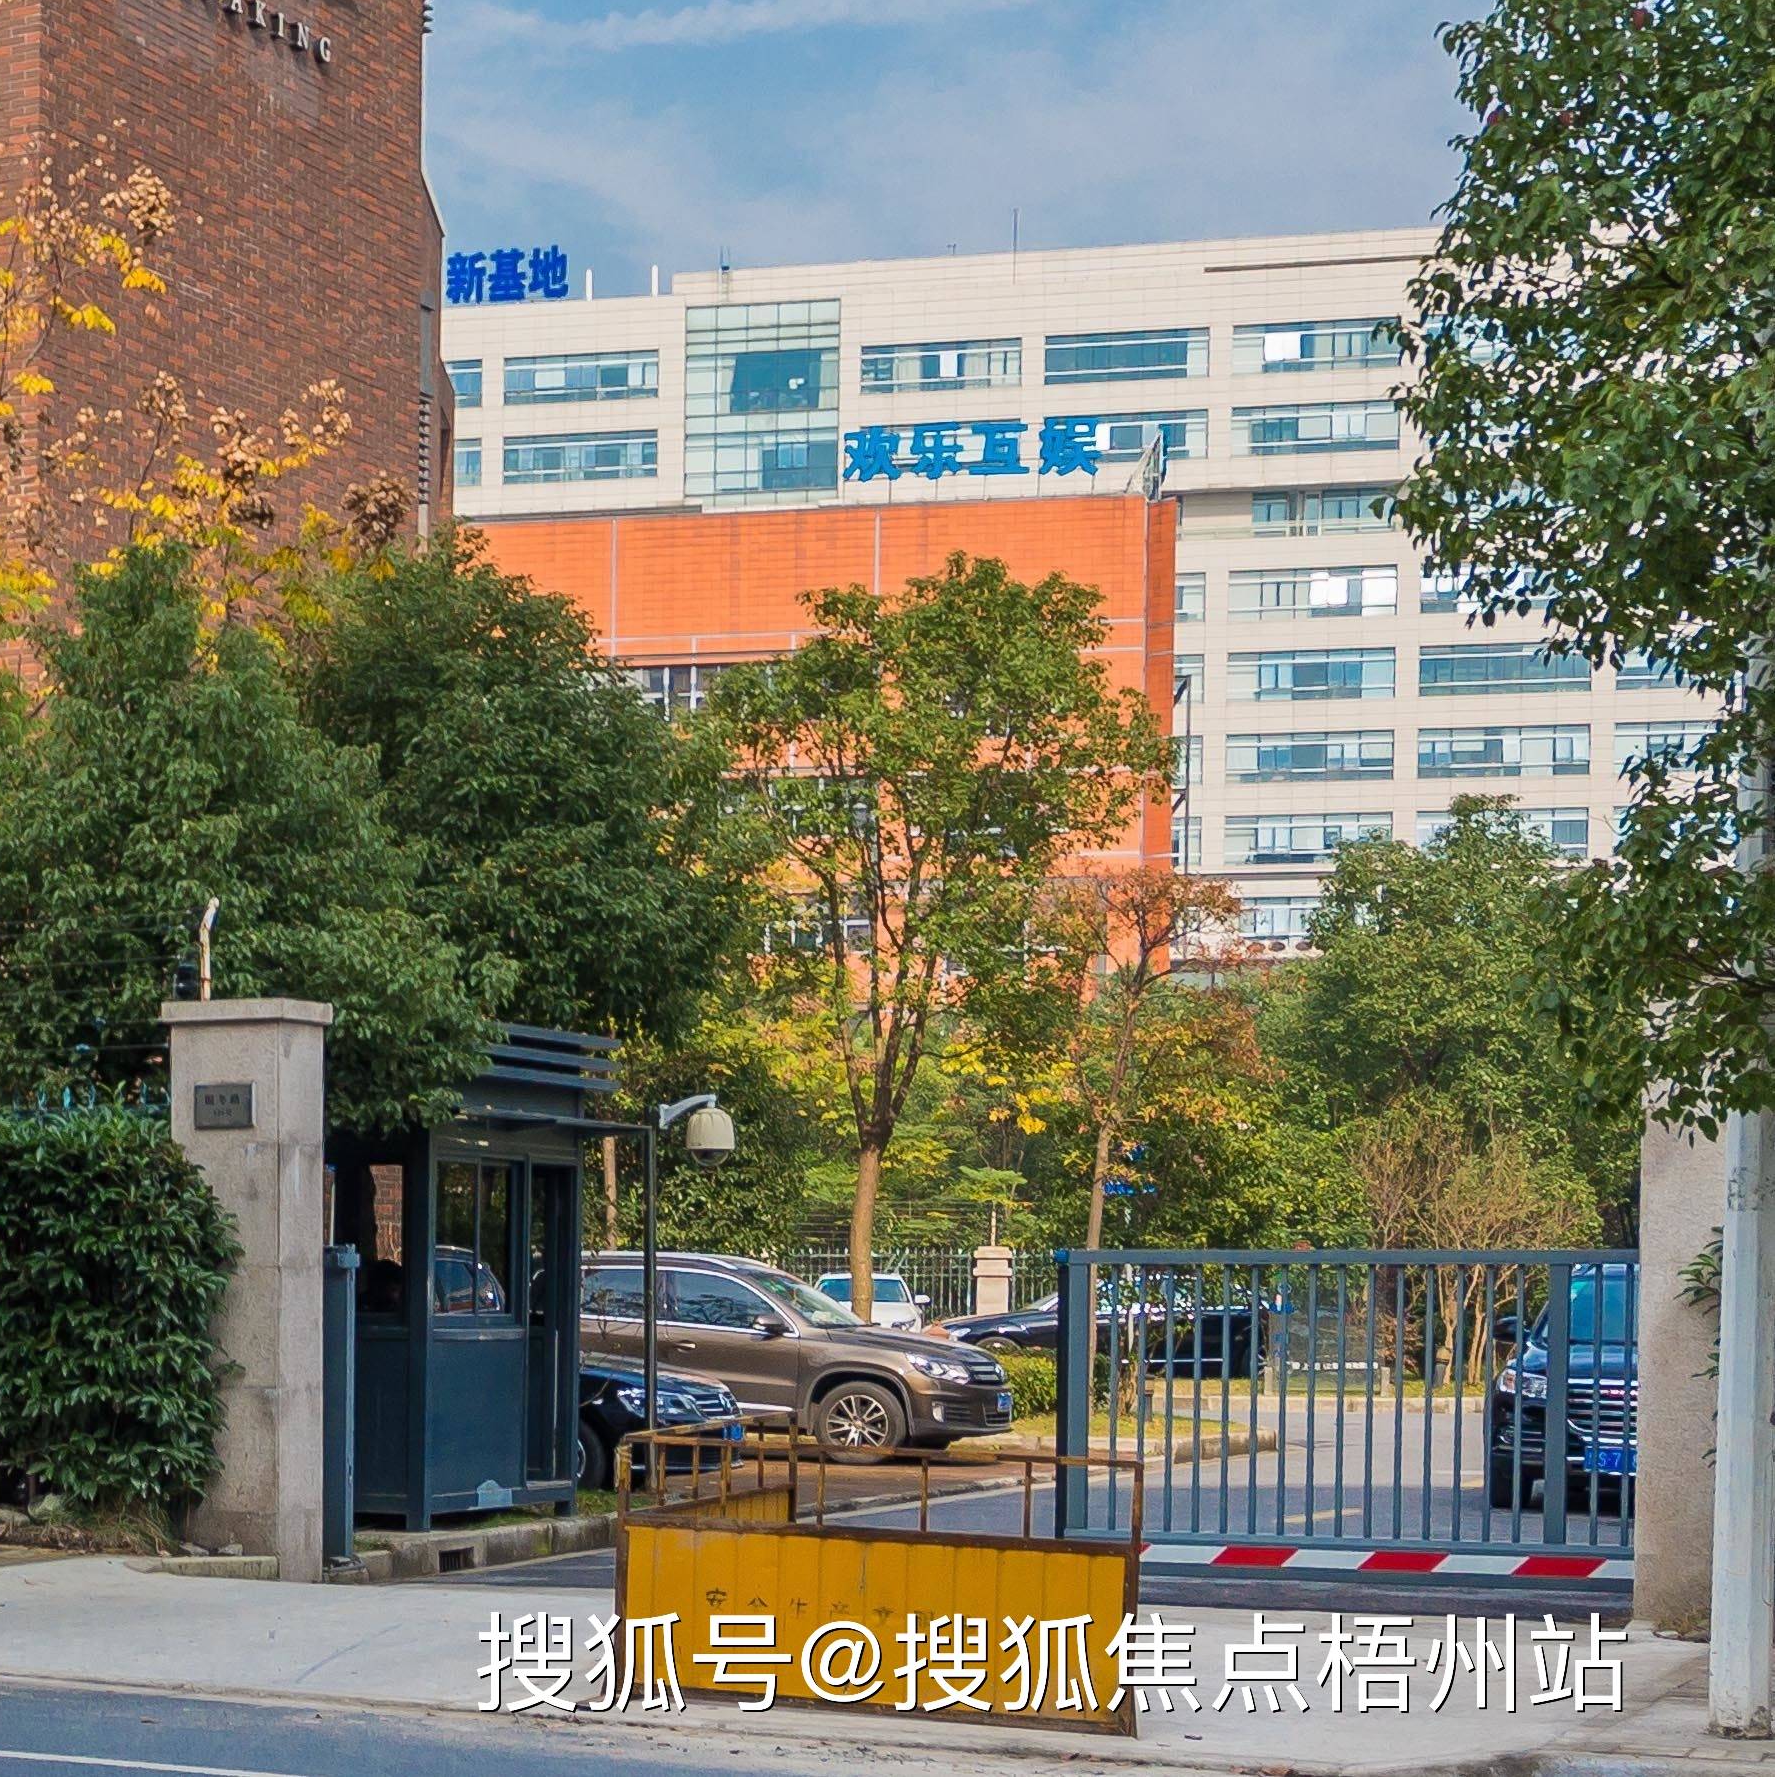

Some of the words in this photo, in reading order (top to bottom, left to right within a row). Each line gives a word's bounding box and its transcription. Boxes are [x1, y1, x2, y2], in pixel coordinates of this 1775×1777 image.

[446, 244, 569, 305] 新基地
[842, 417, 1103, 483] 欢乐互娱
